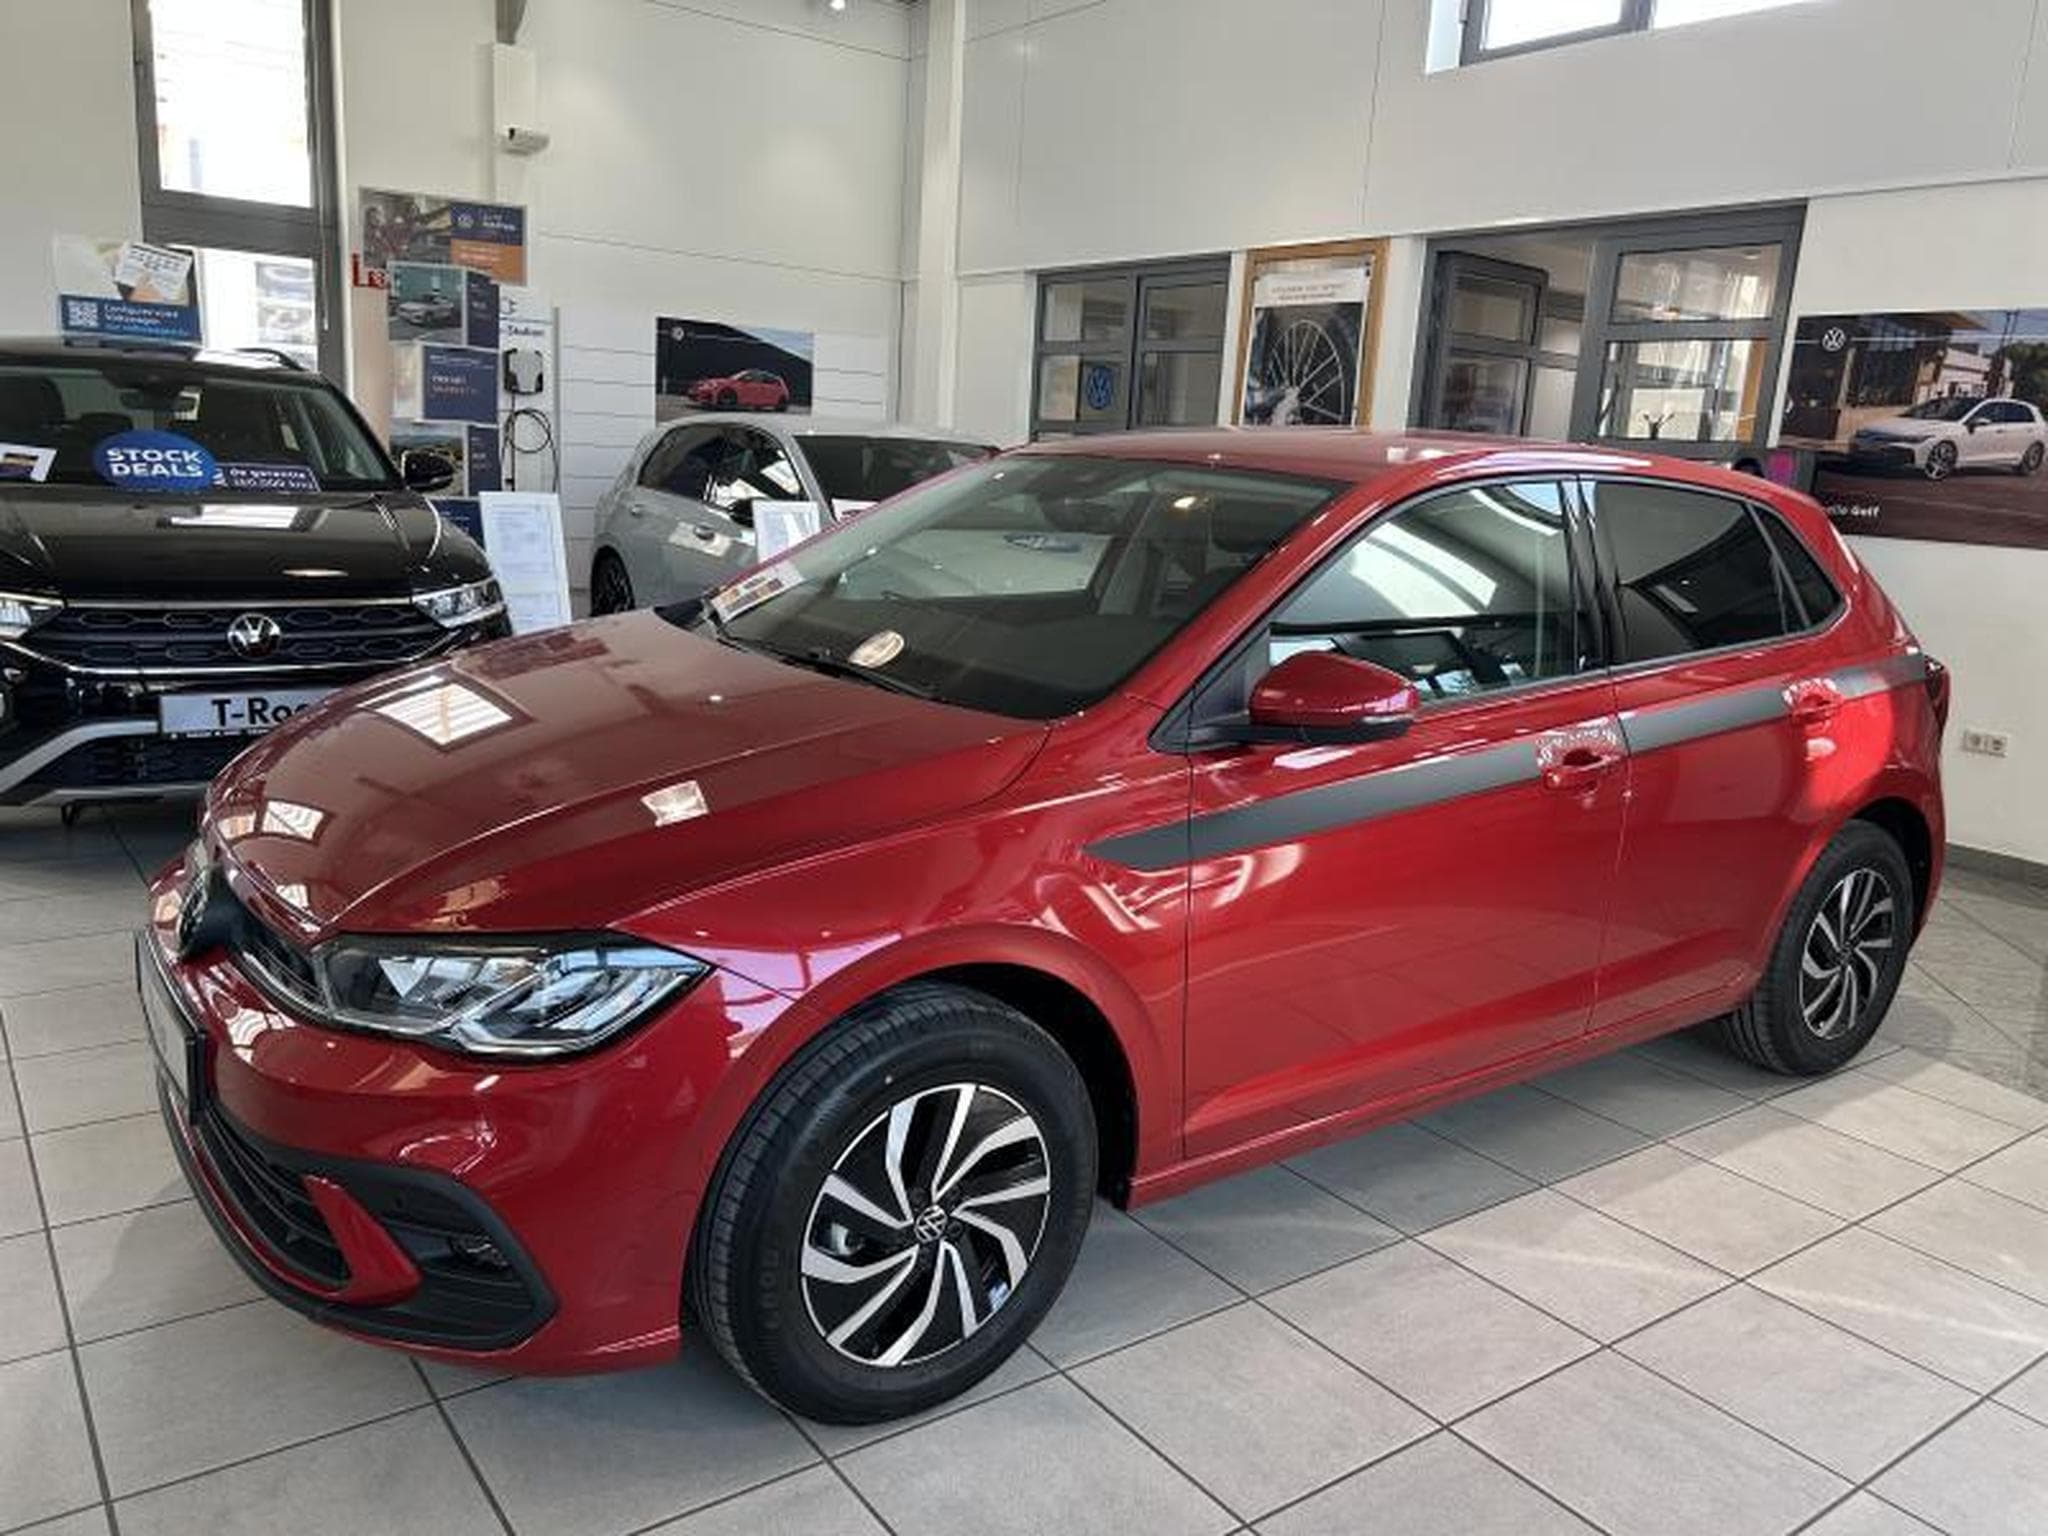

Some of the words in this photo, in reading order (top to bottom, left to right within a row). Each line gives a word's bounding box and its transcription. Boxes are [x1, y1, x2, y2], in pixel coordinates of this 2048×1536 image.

[106, 447, 202, 464] STOCK
[110, 463, 204, 478] DEALS
[1850, 503, 1881, 518] Golf
